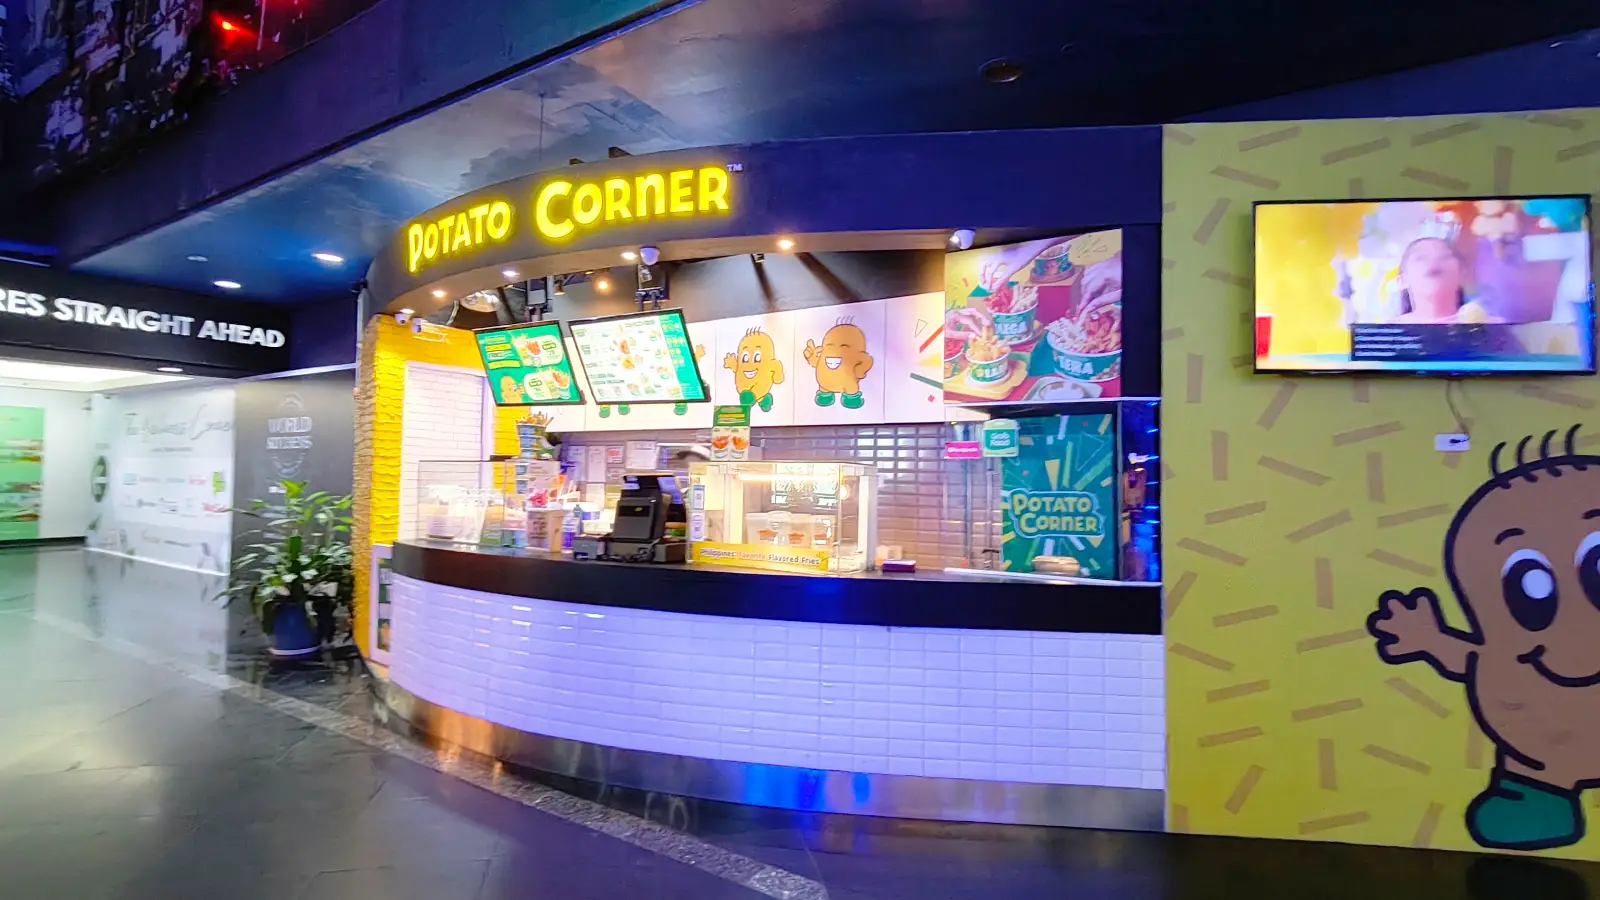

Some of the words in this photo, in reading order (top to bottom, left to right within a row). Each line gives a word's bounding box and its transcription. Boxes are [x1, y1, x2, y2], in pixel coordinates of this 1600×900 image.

[407, 201, 511, 273] POTATO
[535, 166, 729, 239] CORNER
[53, 298, 195, 336] STRAIGHT
[197, 320, 286, 348] AHEAD
[1012, 493, 1092, 515] POTATO
[1020, 512, 1097, 533] CORNER
[768, 553, 799, 563] Flavored
[801, 556, 820, 565] Fries
